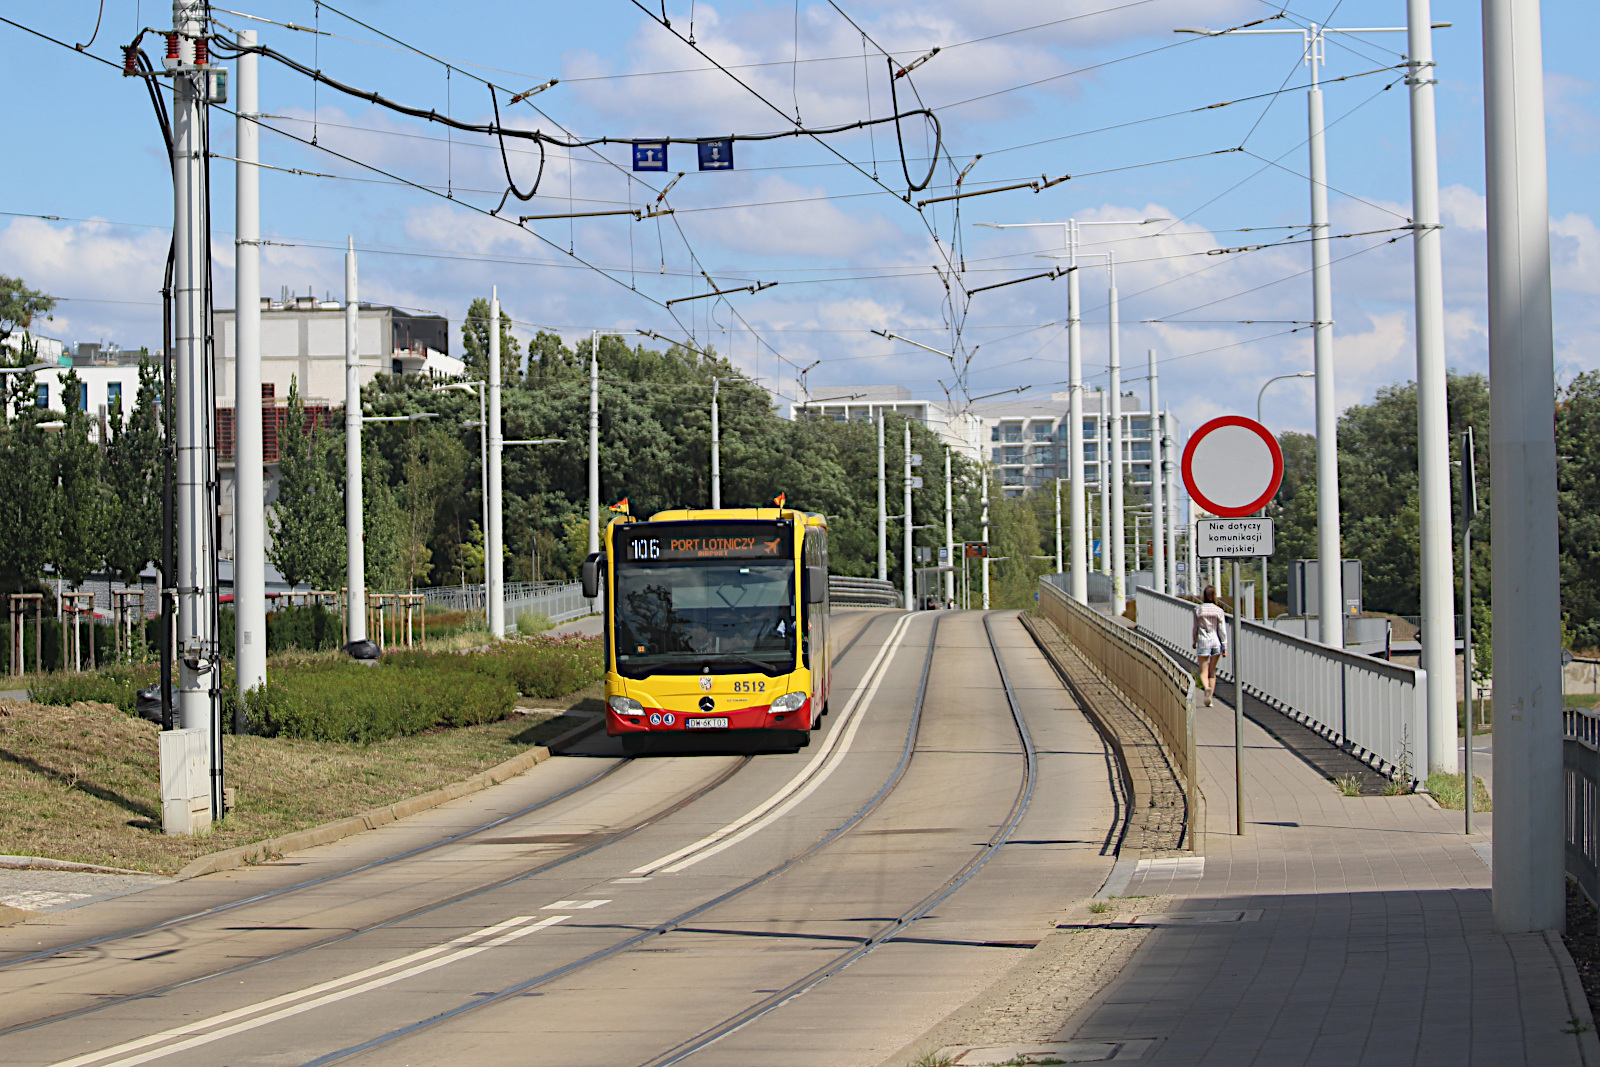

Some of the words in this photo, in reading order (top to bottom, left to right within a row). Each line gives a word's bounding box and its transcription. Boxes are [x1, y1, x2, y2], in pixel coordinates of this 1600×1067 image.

[1209, 522, 1225, 530] Nie
[1228, 522, 1261, 531] dotyczy
[1208, 533, 1262, 542] komunikacji
[631, 538, 660, 559] 106
[670, 539, 699, 551] PORT
[702, 537, 755, 550] LOTNICZY
[1216, 544, 1255, 554] miejskiej
[734, 681, 766, 692] 8512
[690, 719, 701, 727] DW
[703, 719, 726, 727] 6KT03
